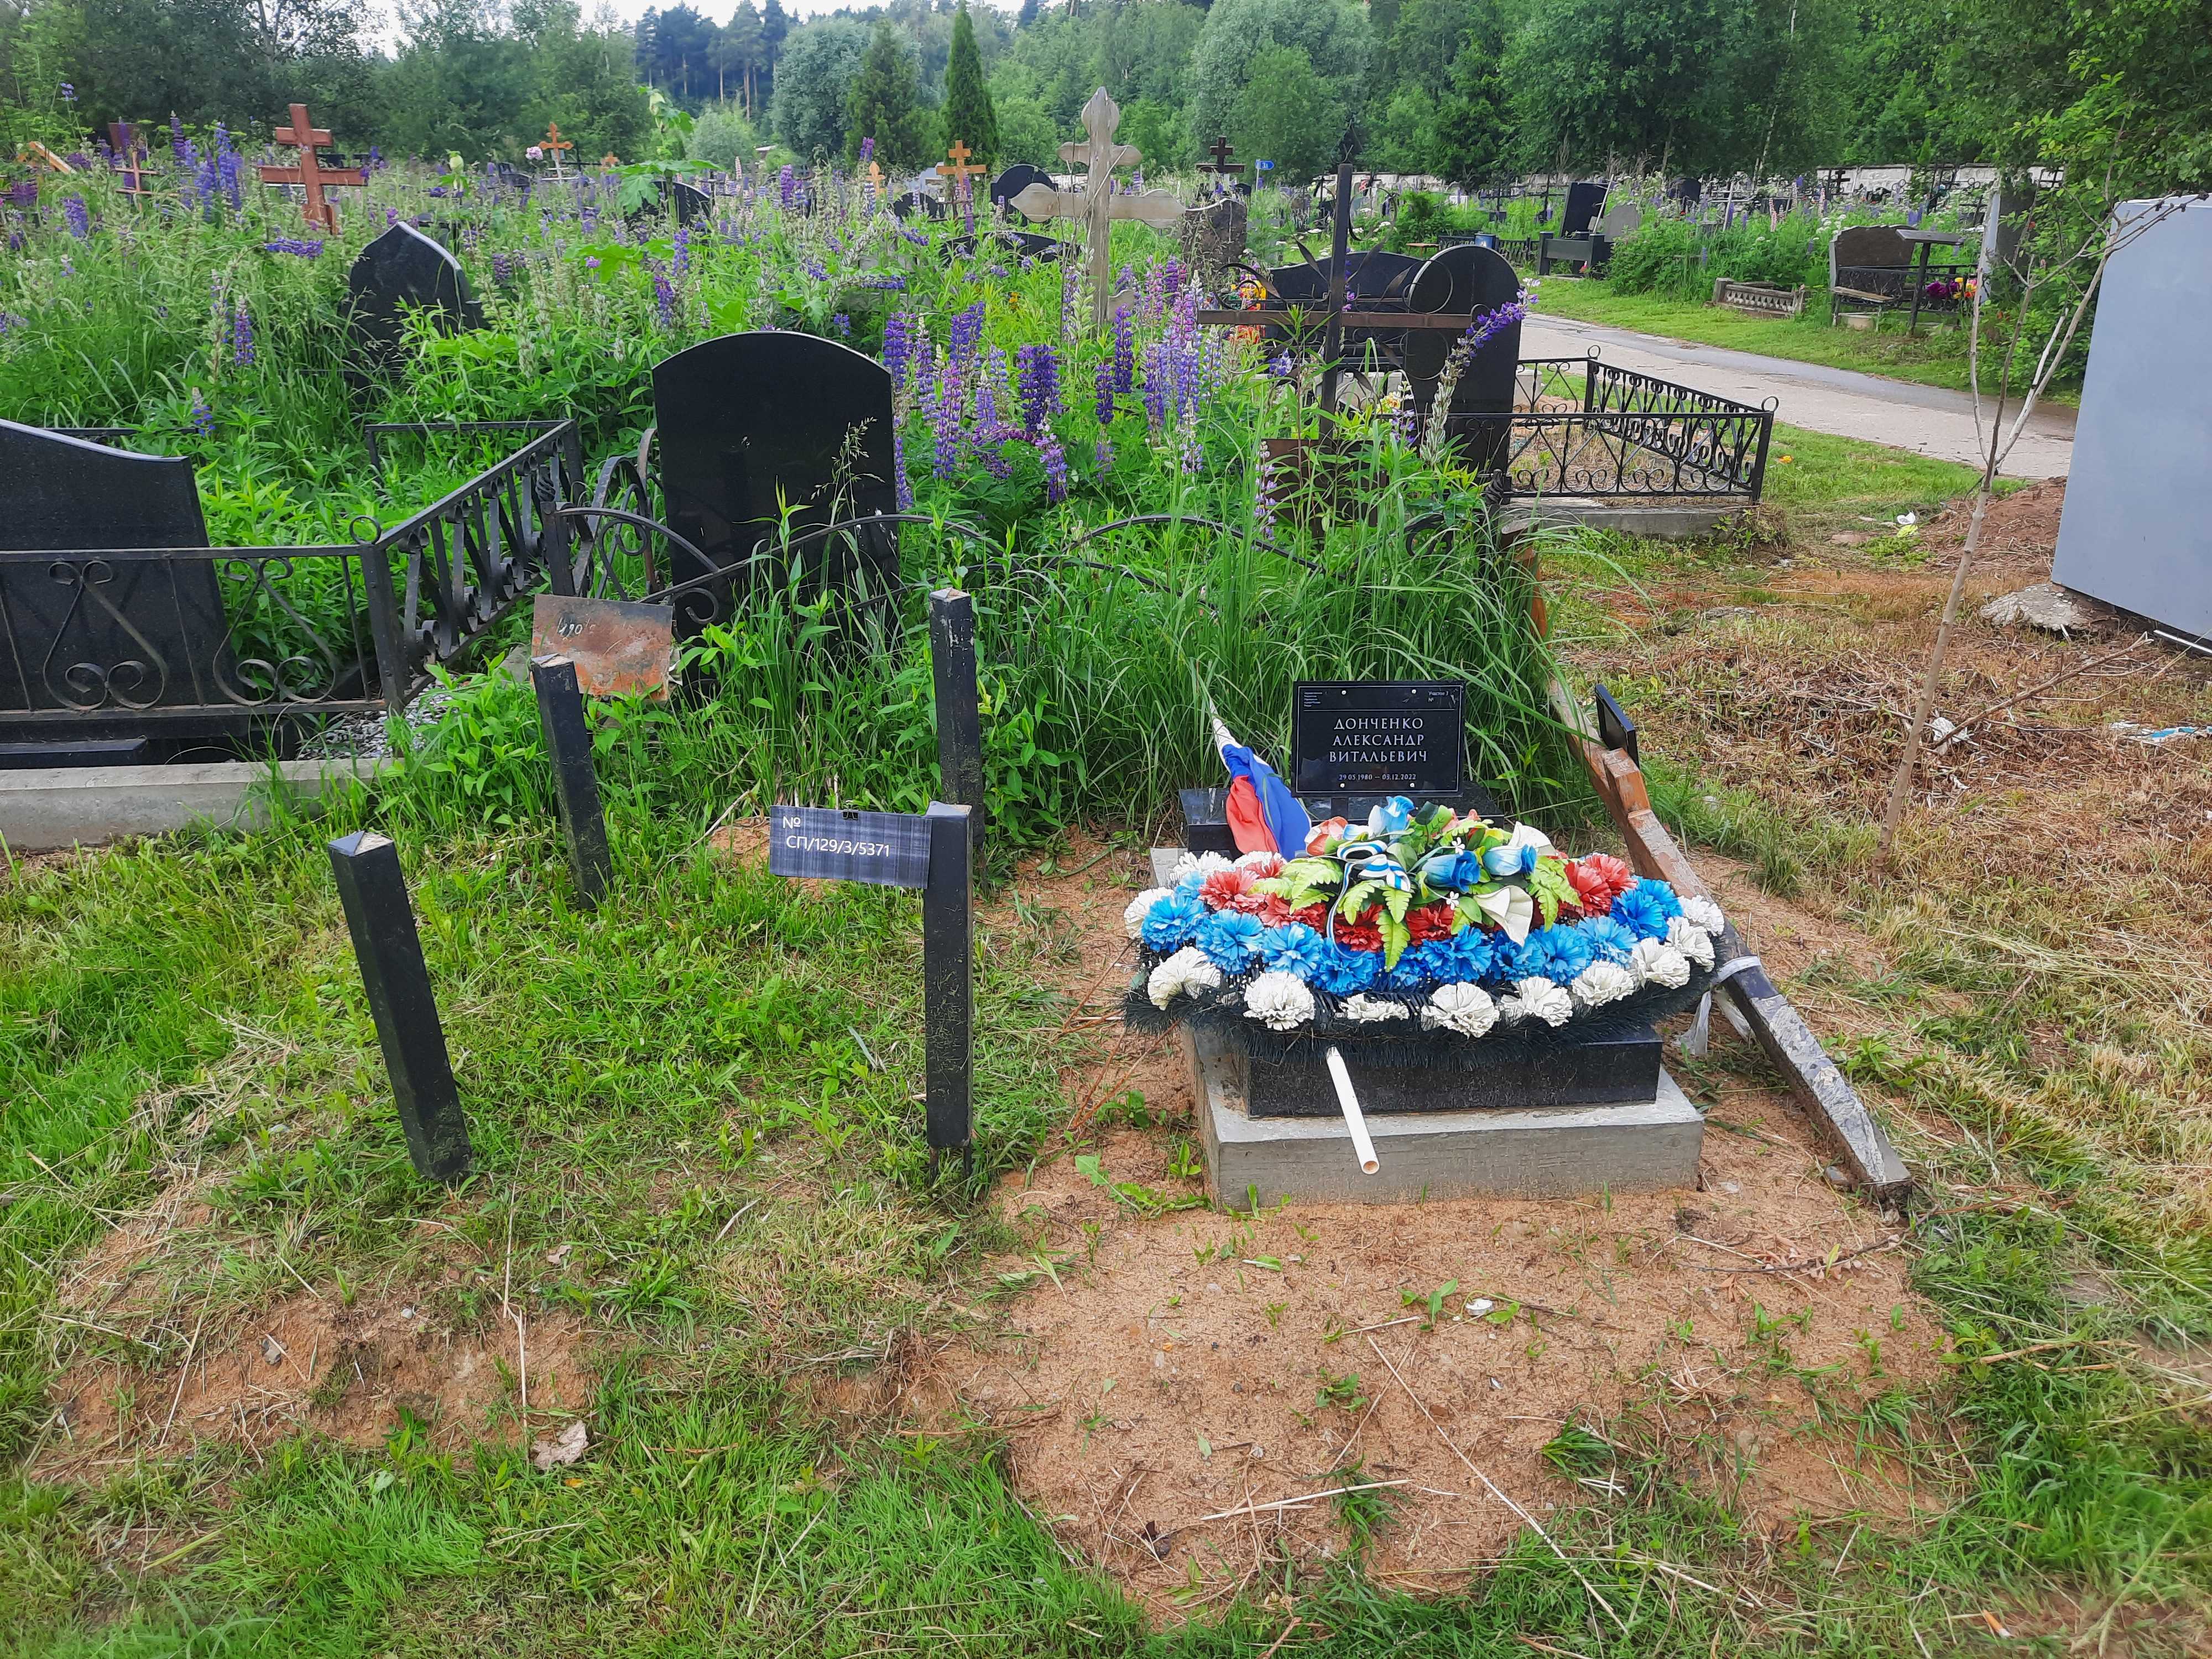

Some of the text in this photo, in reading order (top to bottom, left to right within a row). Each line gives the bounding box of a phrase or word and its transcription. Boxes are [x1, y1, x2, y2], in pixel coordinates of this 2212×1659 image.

[1334, 718, 1423, 730] ДОНЧЕНКО
[1332, 734, 1425, 746] АЛЕКСАНДР
[1329, 751, 1427, 762] ВИТАЛЬЕВИЧ
[782, 816, 801, 830] №
[786, 835, 890, 857] СП/129/3/5371
